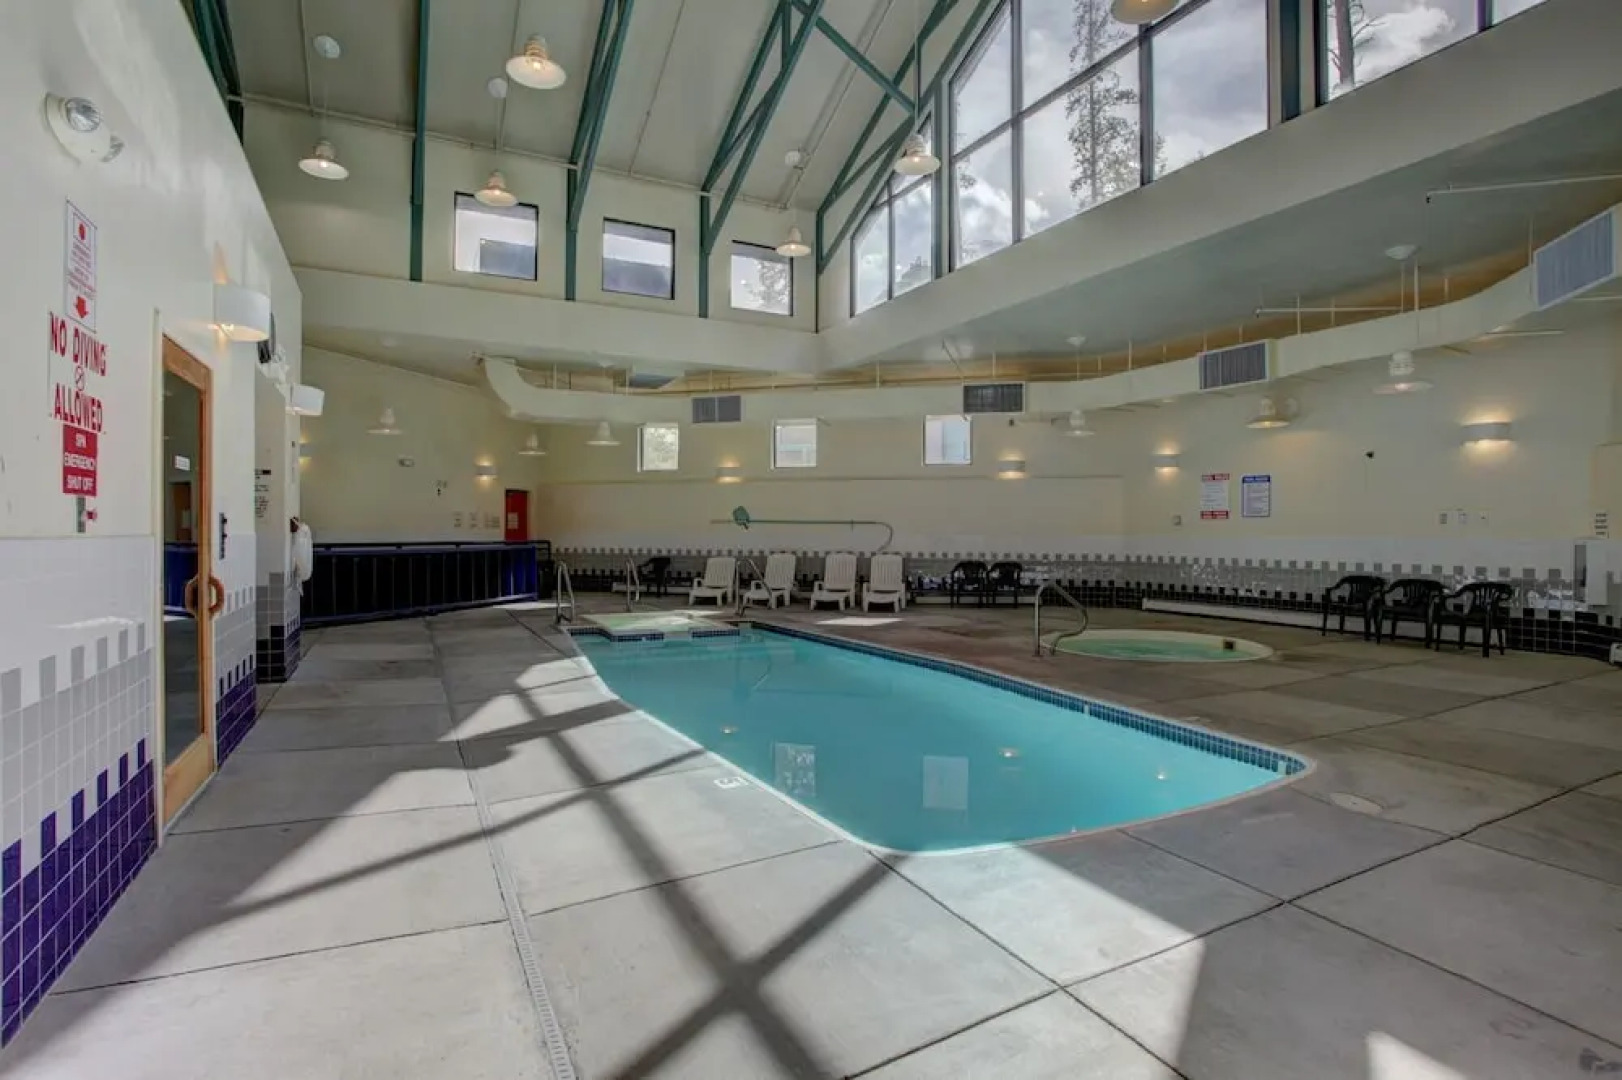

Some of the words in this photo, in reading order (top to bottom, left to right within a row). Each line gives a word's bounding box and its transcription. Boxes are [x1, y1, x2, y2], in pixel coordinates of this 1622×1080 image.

[50, 311, 67, 357] NO
[73, 326, 106, 376] DIVING
[55, 382, 102, 432] ALLOWED
[64, 452, 96, 470] EMERGENCY
